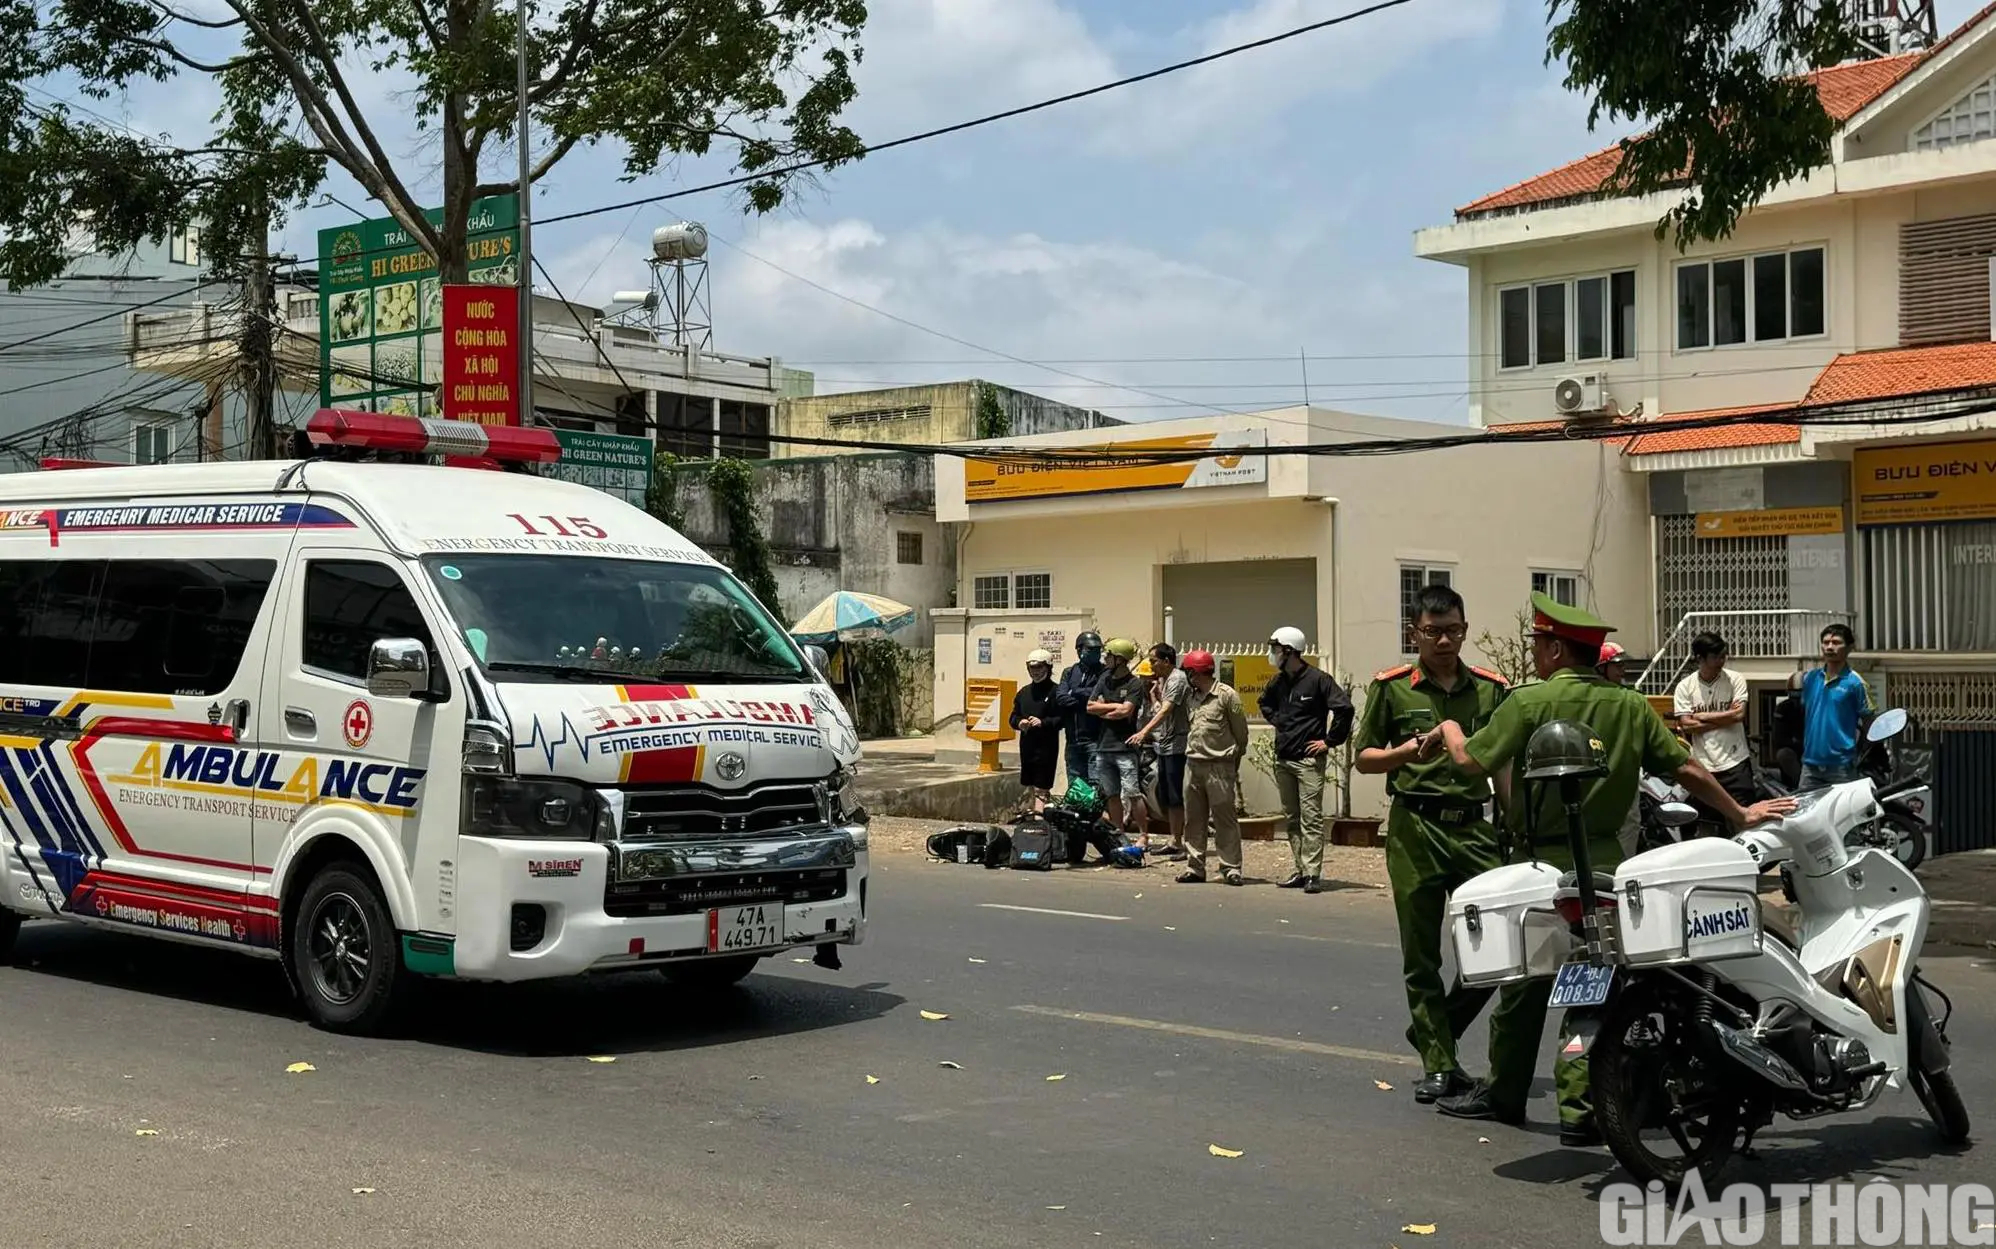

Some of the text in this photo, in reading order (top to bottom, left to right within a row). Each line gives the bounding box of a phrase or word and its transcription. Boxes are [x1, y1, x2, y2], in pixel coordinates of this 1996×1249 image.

[371, 258, 388, 277] HI
[466, 299, 495, 319] NƯỚC
[455, 326, 484, 350] CỘNG
[464, 354, 499, 377] XÃ HỘI
[454, 380, 510, 402] CHỦ NGHĨA
[573, 448, 603, 462] GREEN
[604, 451, 648, 466] NATURE'S
[1874, 465, 1920, 481] BƯU
[1928, 460, 1979, 478] ĐIỆN
[147, 506, 214, 525] MEDICAR
[216, 504, 286, 523] SERVICE
[505, 513, 608, 539] 115
[538, 539, 641, 556] TRANSPORT
[601, 729, 823, 754] EMERGENCY MEDICAL SERVICE
[131, 742, 428, 808] AMBULANCE
[182, 795, 250, 817] TRANSPORT
[248, 803, 298, 824] SERVICE
[110, 901, 231, 937] Emergency Services Health
[736, 906, 765, 926] 47A
[1727, 901, 1749, 931] SÁT
[724, 926, 775, 948] 449.71
[1553, 982, 1606, 1004] 008.50
